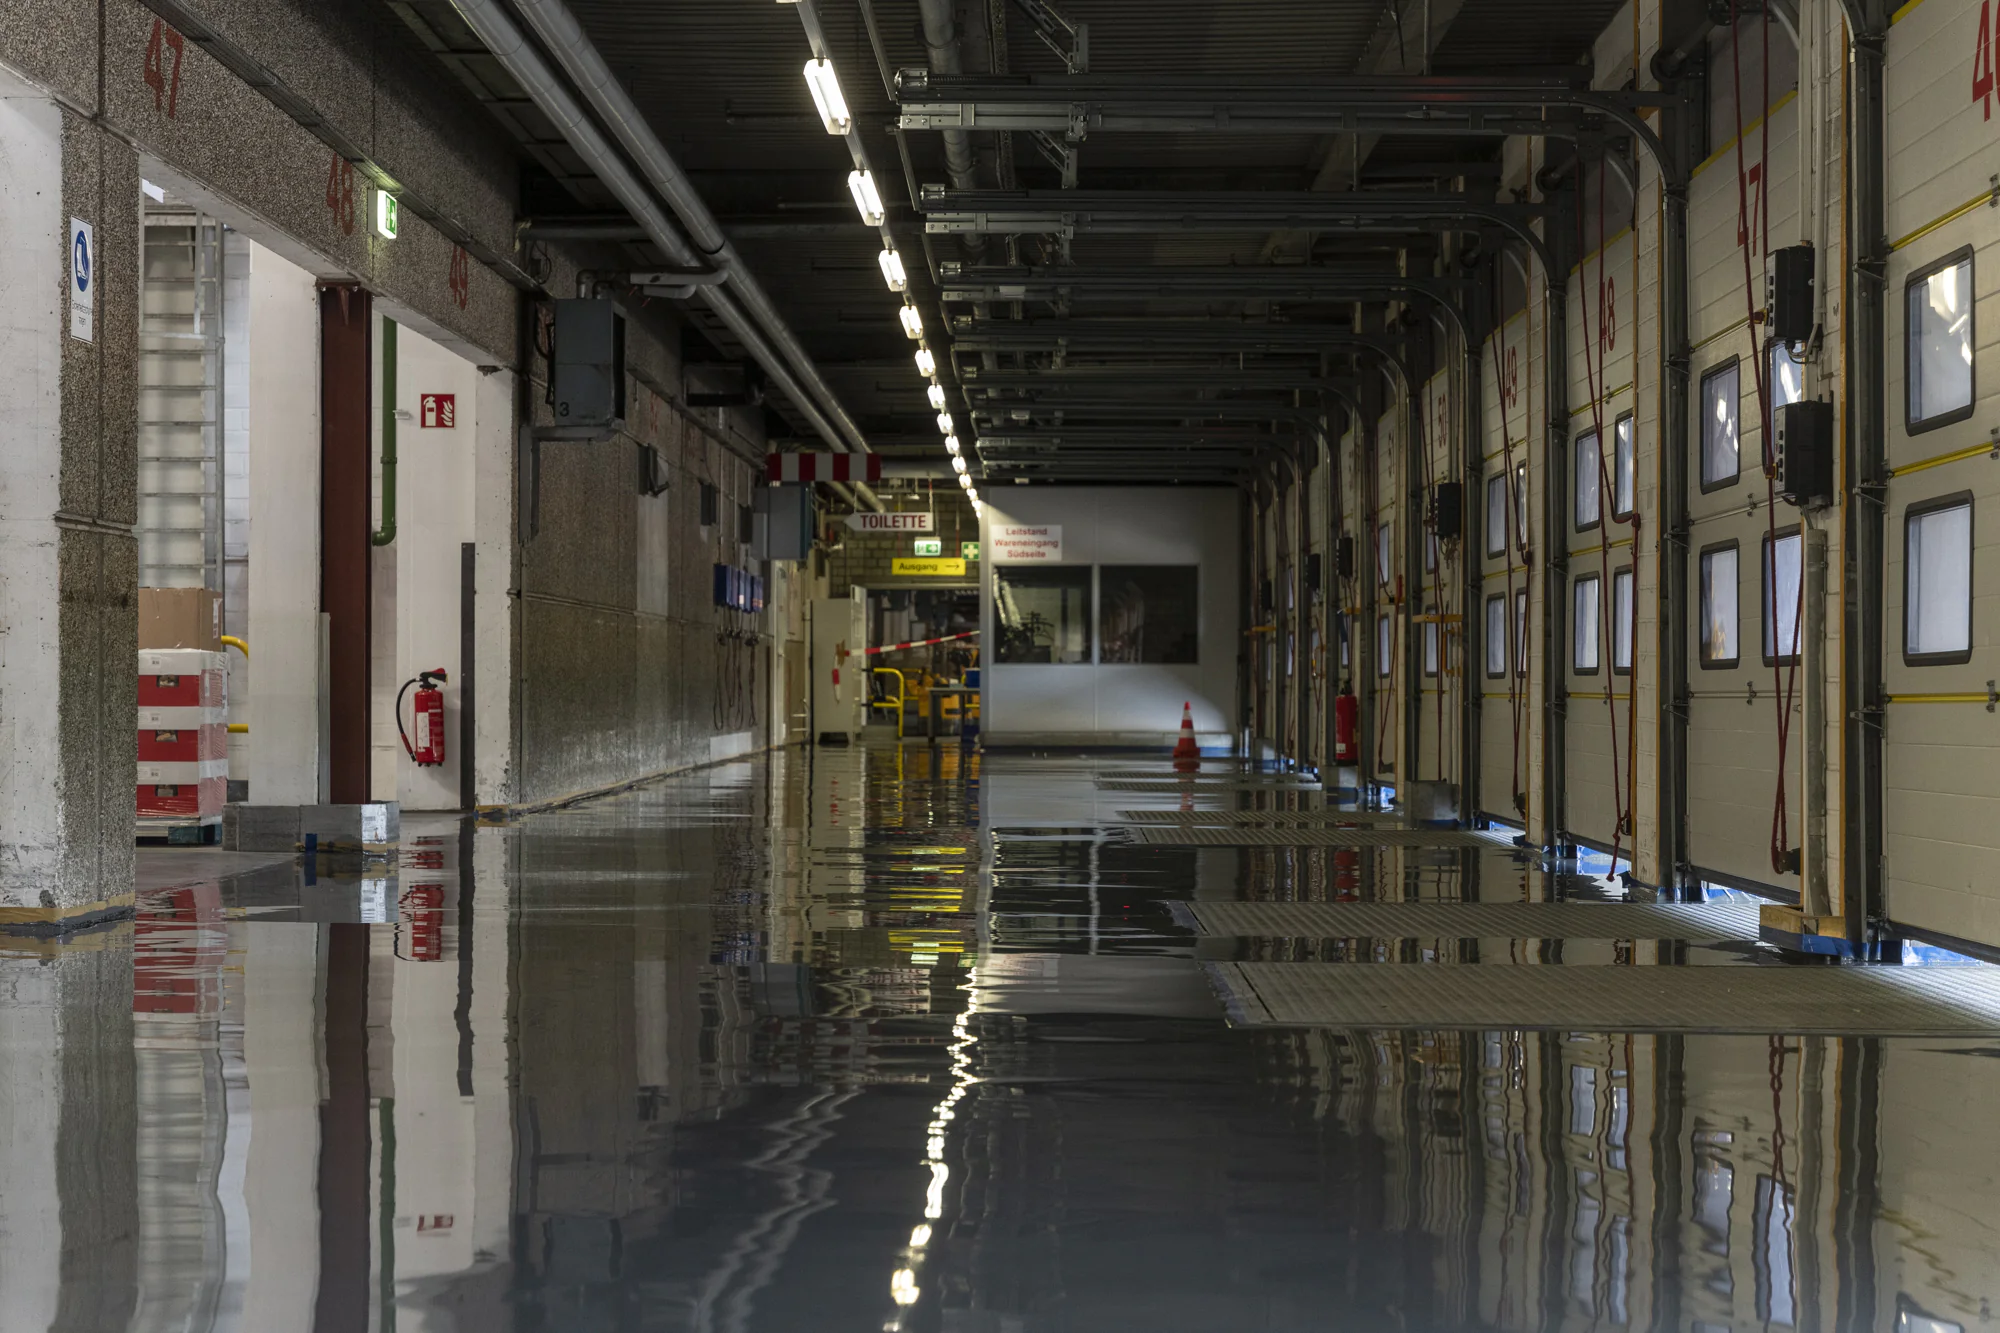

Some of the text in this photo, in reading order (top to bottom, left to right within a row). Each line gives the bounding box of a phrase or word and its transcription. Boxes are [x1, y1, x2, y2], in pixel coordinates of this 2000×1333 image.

[144, 16, 184, 120] 47
[326, 151, 354, 237] 48
[1737, 162, 1761, 263] 47
[450, 243, 468, 311] 49
[1506, 345, 1518, 409] 49
[559, 402, 570, 418] 3
[860, 514, 926, 529] TOILETTE
[1006, 527, 1048, 536] Leitstand
[995, 539, 1059, 549] Wareneingang
[1007, 549, 1046, 558] Südseite
[899, 562, 938, 572] Ausgang
